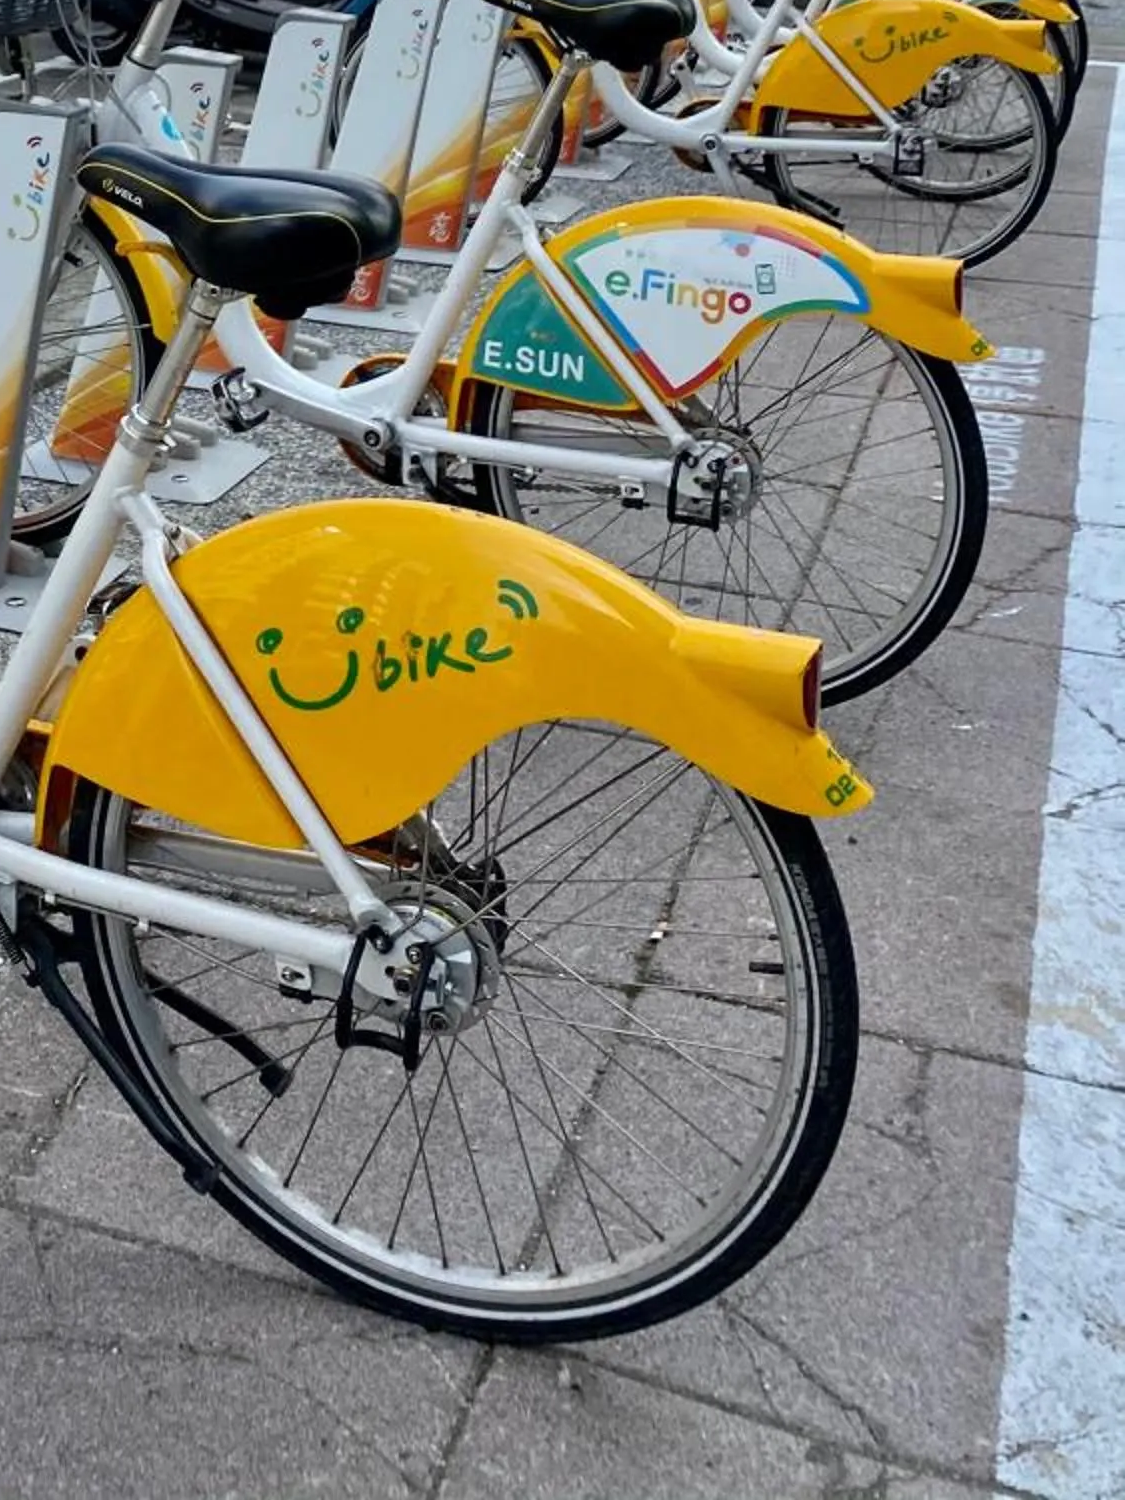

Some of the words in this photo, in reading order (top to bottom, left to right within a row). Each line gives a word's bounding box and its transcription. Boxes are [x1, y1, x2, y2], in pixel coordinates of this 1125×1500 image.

[113, 186, 144, 209] VELO
[604, 268, 752, 324] e.Fingo
[483, 339, 585, 382] E.SUN
